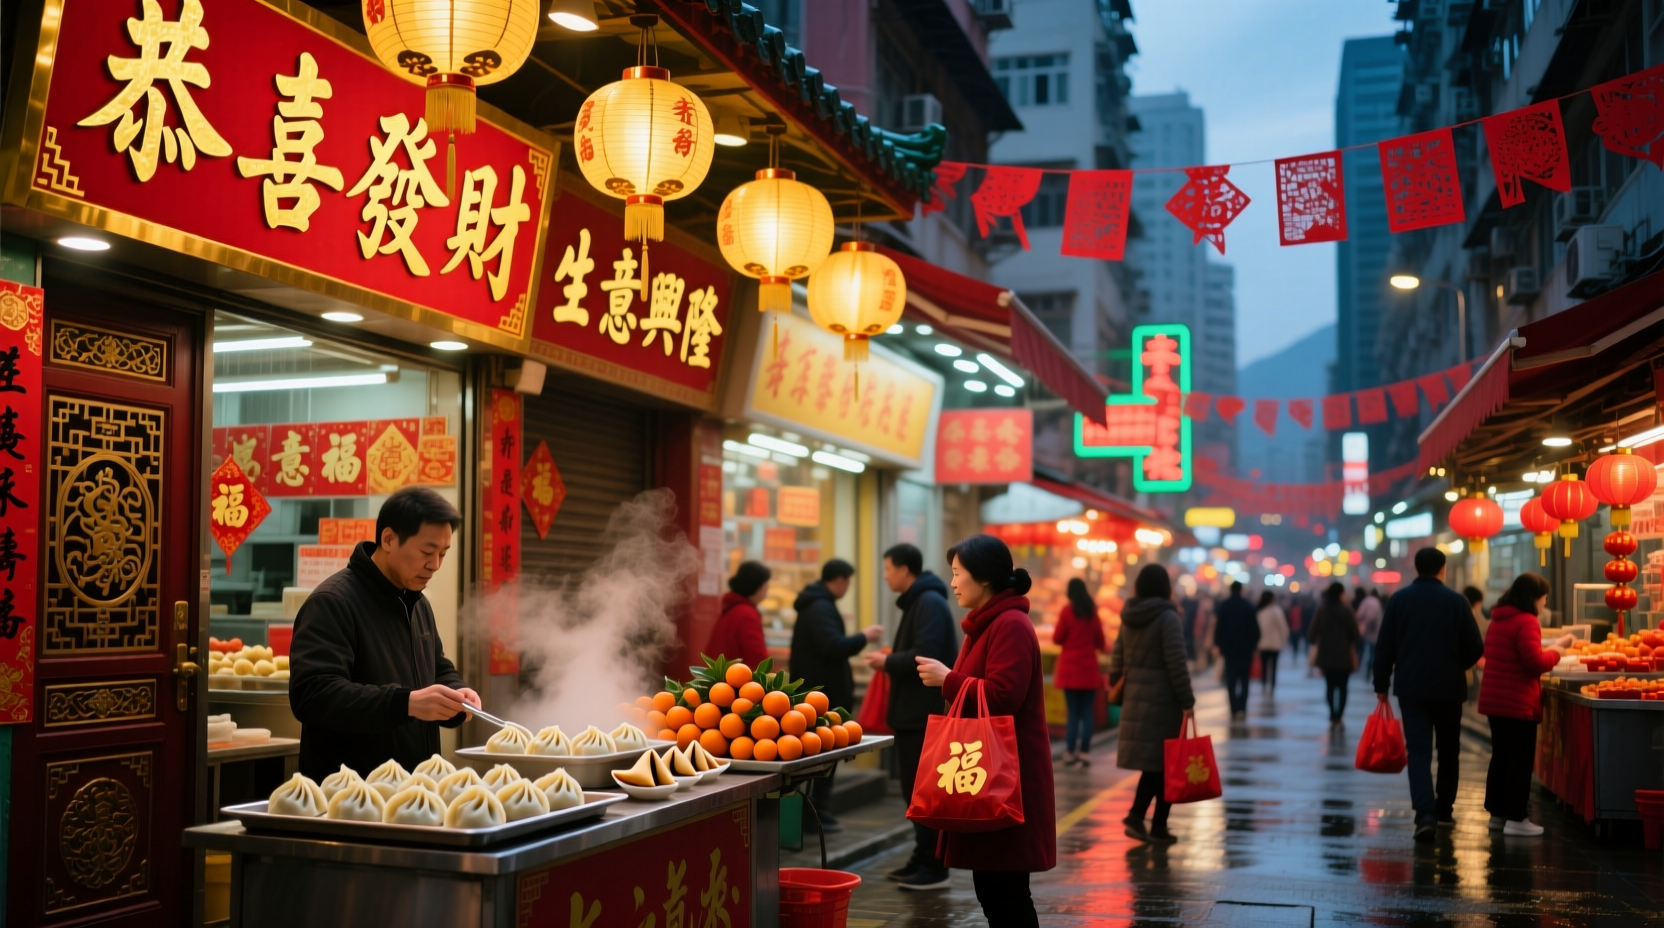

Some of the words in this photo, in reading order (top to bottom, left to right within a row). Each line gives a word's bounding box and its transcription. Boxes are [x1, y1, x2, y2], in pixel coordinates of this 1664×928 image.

[77, 0, 531, 302] 恭喜發財
[553, 228, 722, 369] 生意興隆
[212, 483, 249, 528] 福
[937, 740, 988, 796] 福
